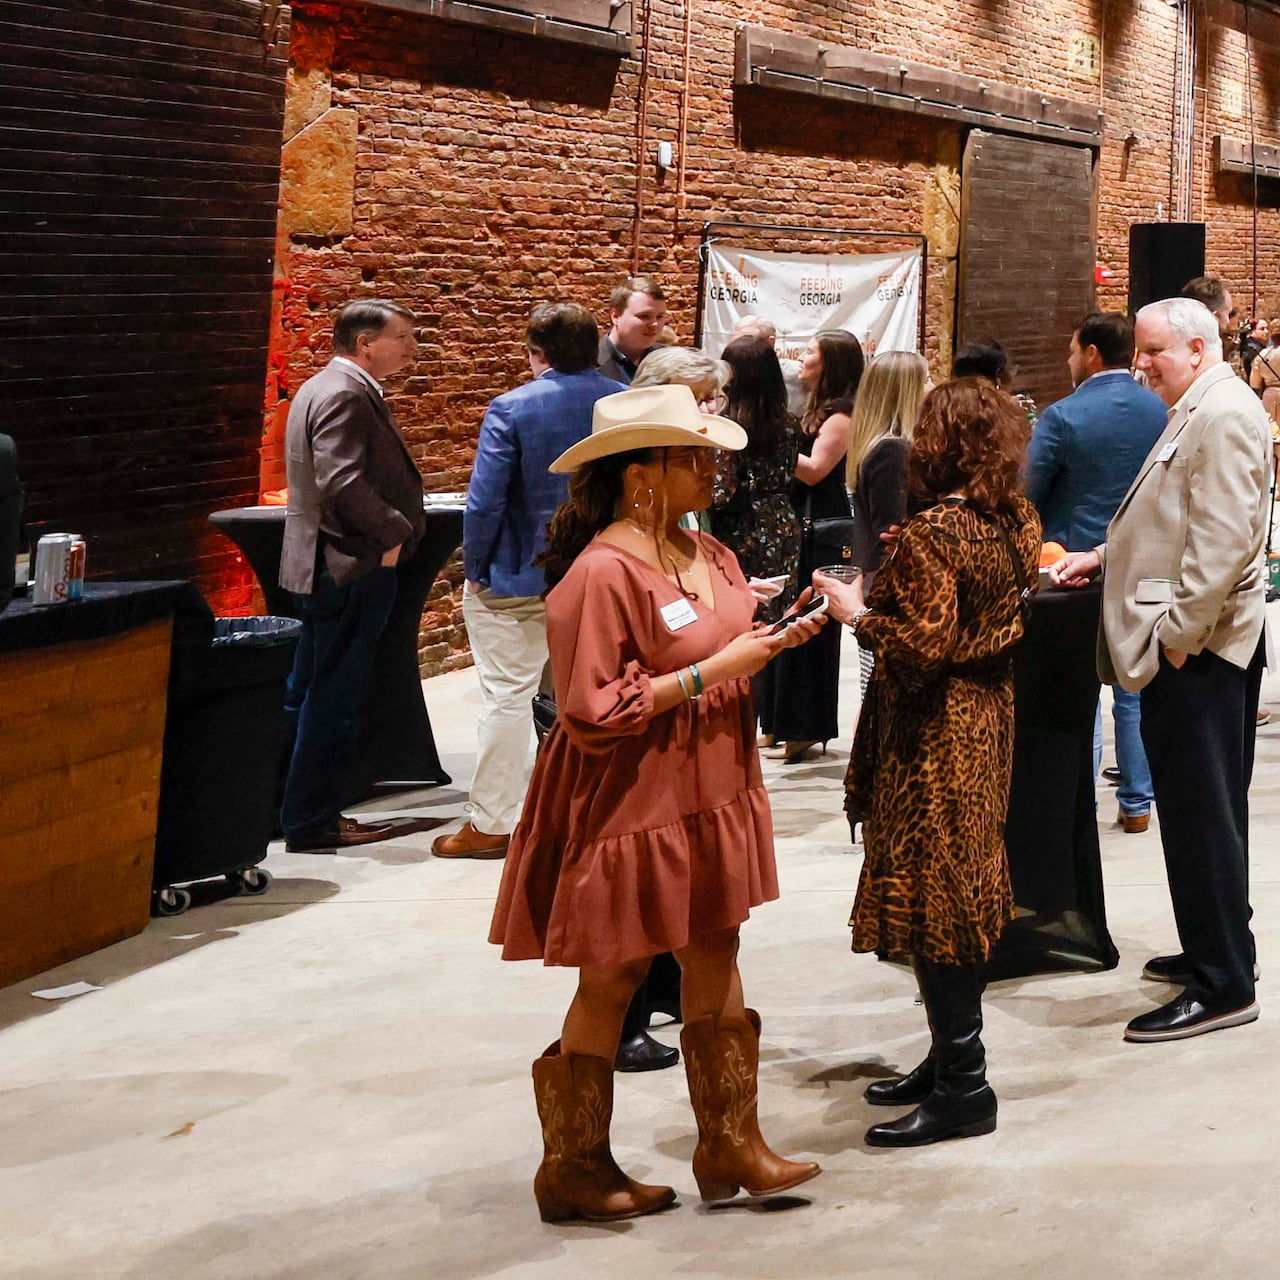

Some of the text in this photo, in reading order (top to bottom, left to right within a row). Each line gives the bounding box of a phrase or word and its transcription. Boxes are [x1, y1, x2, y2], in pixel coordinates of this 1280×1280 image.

[800, 276, 843, 290] FEEDING
[710, 286, 758, 304] GEORGIA
[800, 292, 841, 306] GEORGIA
